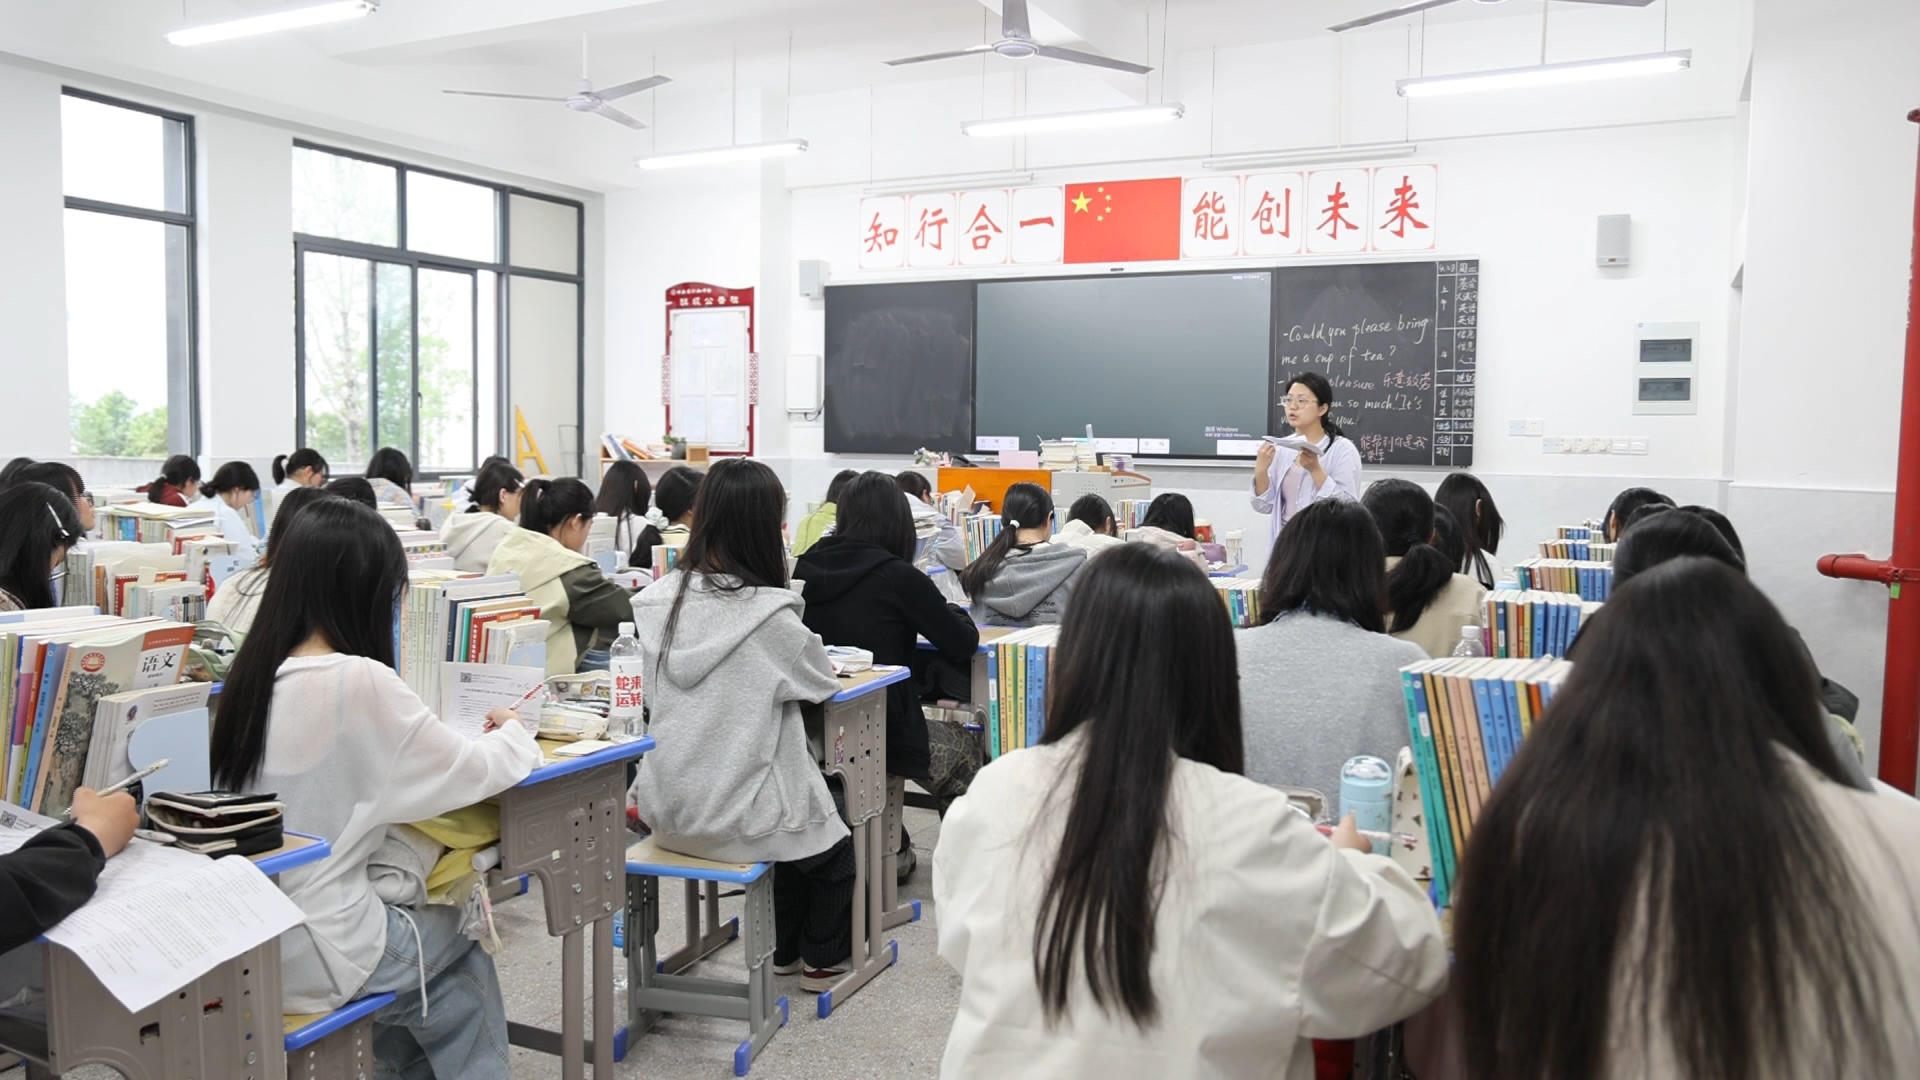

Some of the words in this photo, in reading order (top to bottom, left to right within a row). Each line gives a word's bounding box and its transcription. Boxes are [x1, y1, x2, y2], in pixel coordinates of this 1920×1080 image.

[1193, 176, 1429, 240] 能创未来
[864, 204, 1054, 252] 知行合一
[1328, 326, 1347, 346] you
[1352, 319, 1392, 346] please
[1397, 314, 1430, 344] bring
[1281, 354, 1297, 366] me
[1303, 354, 1310, 363] a
[1315, 353, 1334, 374] cup
[1339, 346, 1358, 376] of
[1348, 400, 1359, 408] so
[142, 652, 176, 673] 语文
[616, 676, 641, 690] 蛇来
[616, 692, 641, 707] 运转
